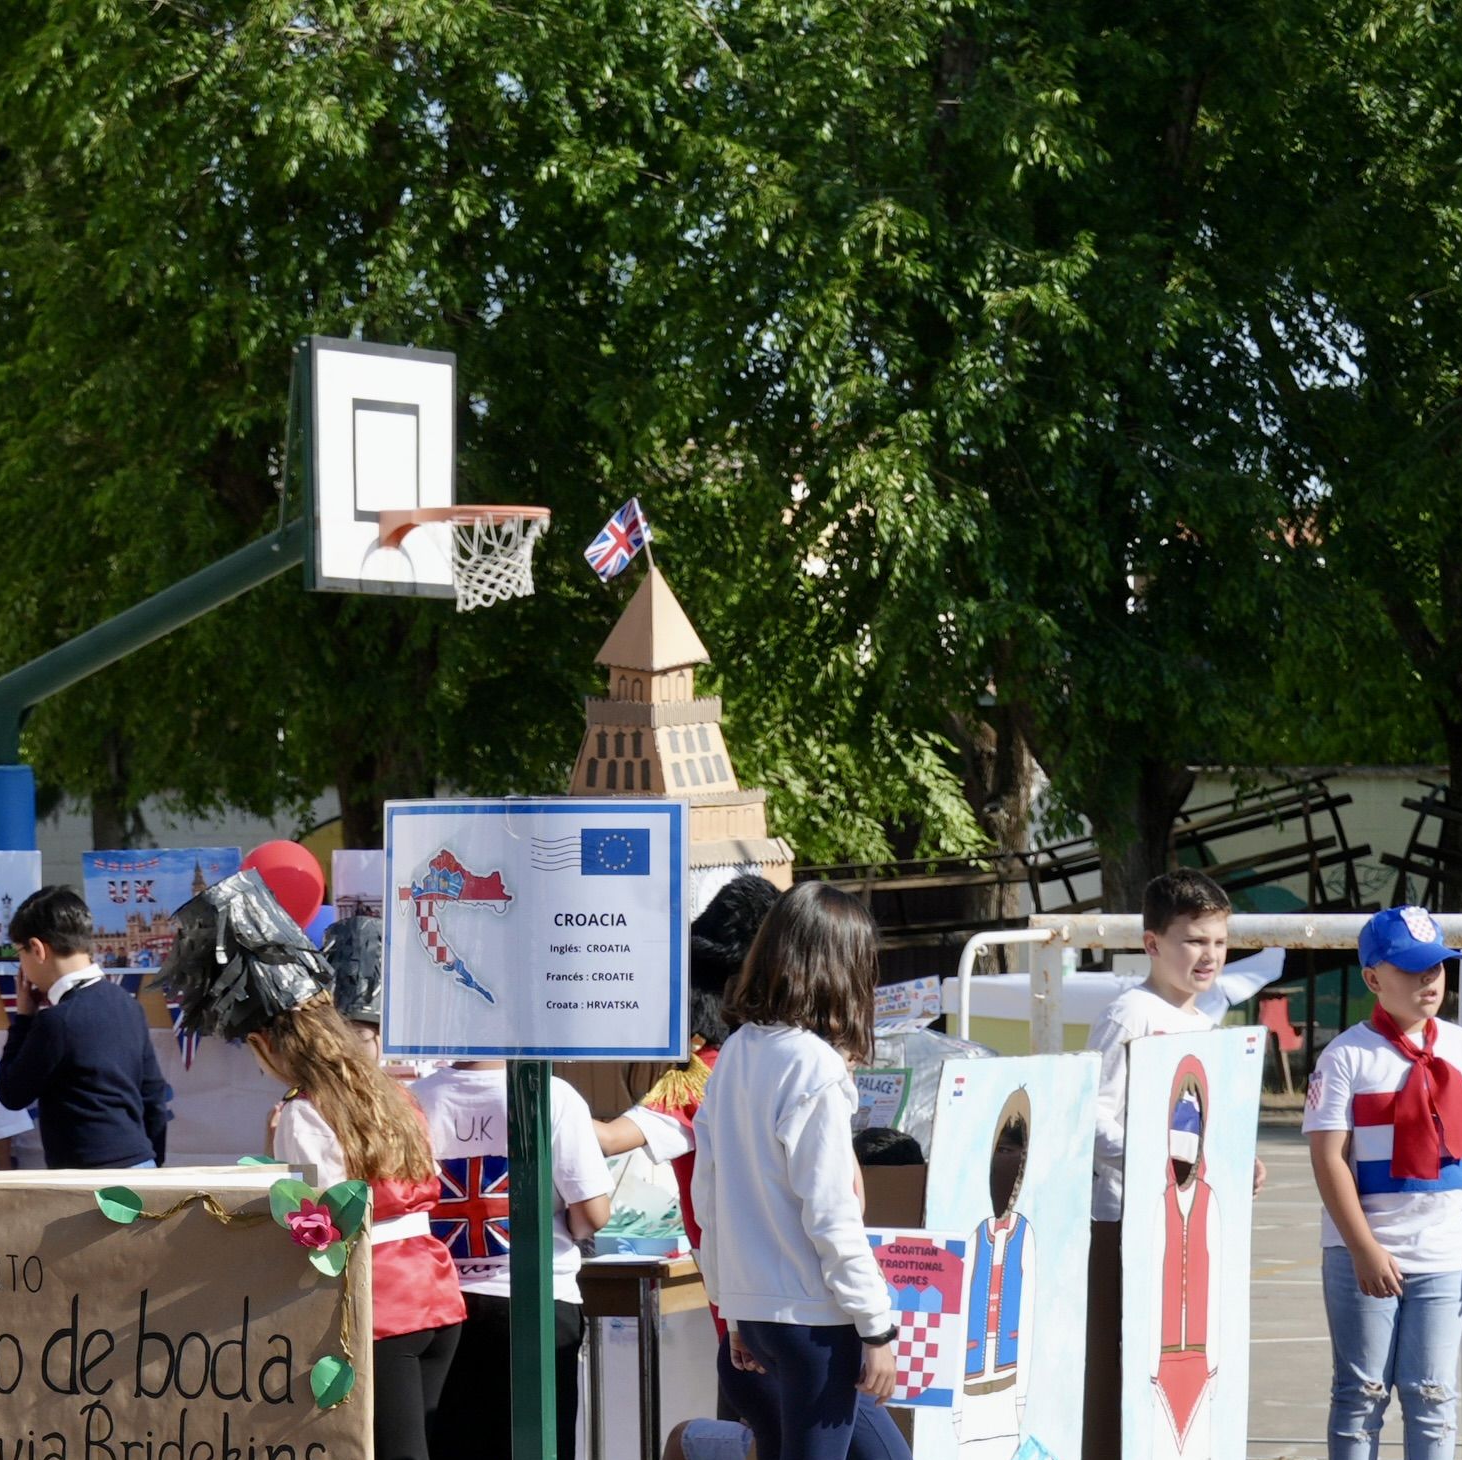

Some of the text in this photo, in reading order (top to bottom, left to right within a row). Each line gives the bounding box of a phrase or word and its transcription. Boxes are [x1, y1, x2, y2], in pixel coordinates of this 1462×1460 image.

[107, 880, 157, 904] UK
[554, 913, 627, 927] CROACIA
[549, 943, 631, 956] Inglés: CROATIA
[546, 971, 584, 981] Francés
[591, 972, 635, 981] CROATIE
[546, 1000, 578, 1009] Croata
[586, 1000, 640, 1010] HRVATSKA
[858, 1077, 895, 1094] PALACE
[455, 1115, 494, 1142] U.K
[887, 1244, 939, 1257] CROATIAN
[879, 1258, 945, 1273] TRADITIONAL
[892, 1274, 929, 1286] GAMES
[41, 1294, 115, 1396] de
[134, 1289, 296, 1405] boda
